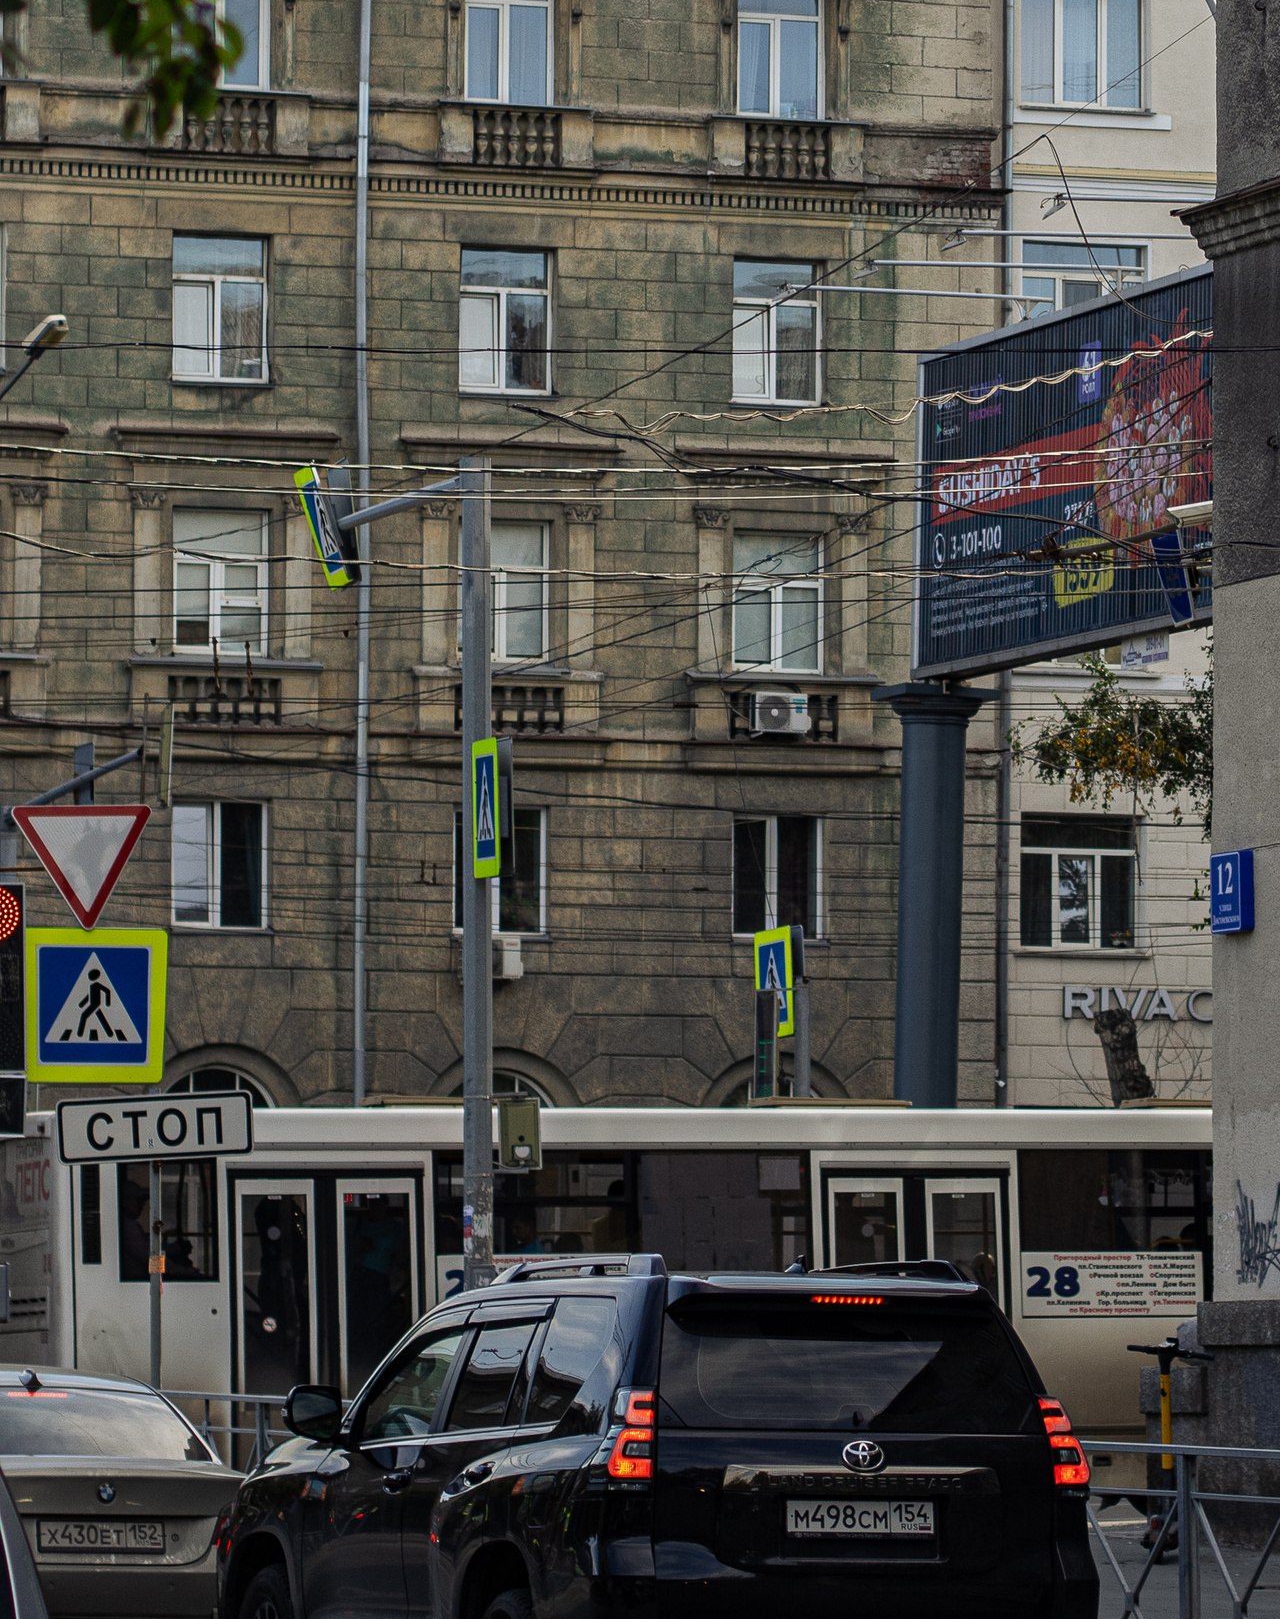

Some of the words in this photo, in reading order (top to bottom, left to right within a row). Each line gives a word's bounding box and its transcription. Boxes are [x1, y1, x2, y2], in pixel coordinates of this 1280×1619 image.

[938, 452, 1040, 513] SUSHIDAY'S
[950, 525, 1002, 559] 3-101-100
[1217, 862, 1233, 895] 12
[1063, 986, 1179, 1021] RIVA
[87, 1106, 224, 1151] СТОП
[1054, 1254, 1102, 1262] Пригородный
[1026, 1266, 1080, 1297] 28
[768, 1475, 815, 1487] LAND
[893, 1504, 927, 1523] 154
[901, 1523, 918, 1531] RUS
[129, 1525, 158, 1540] 152
